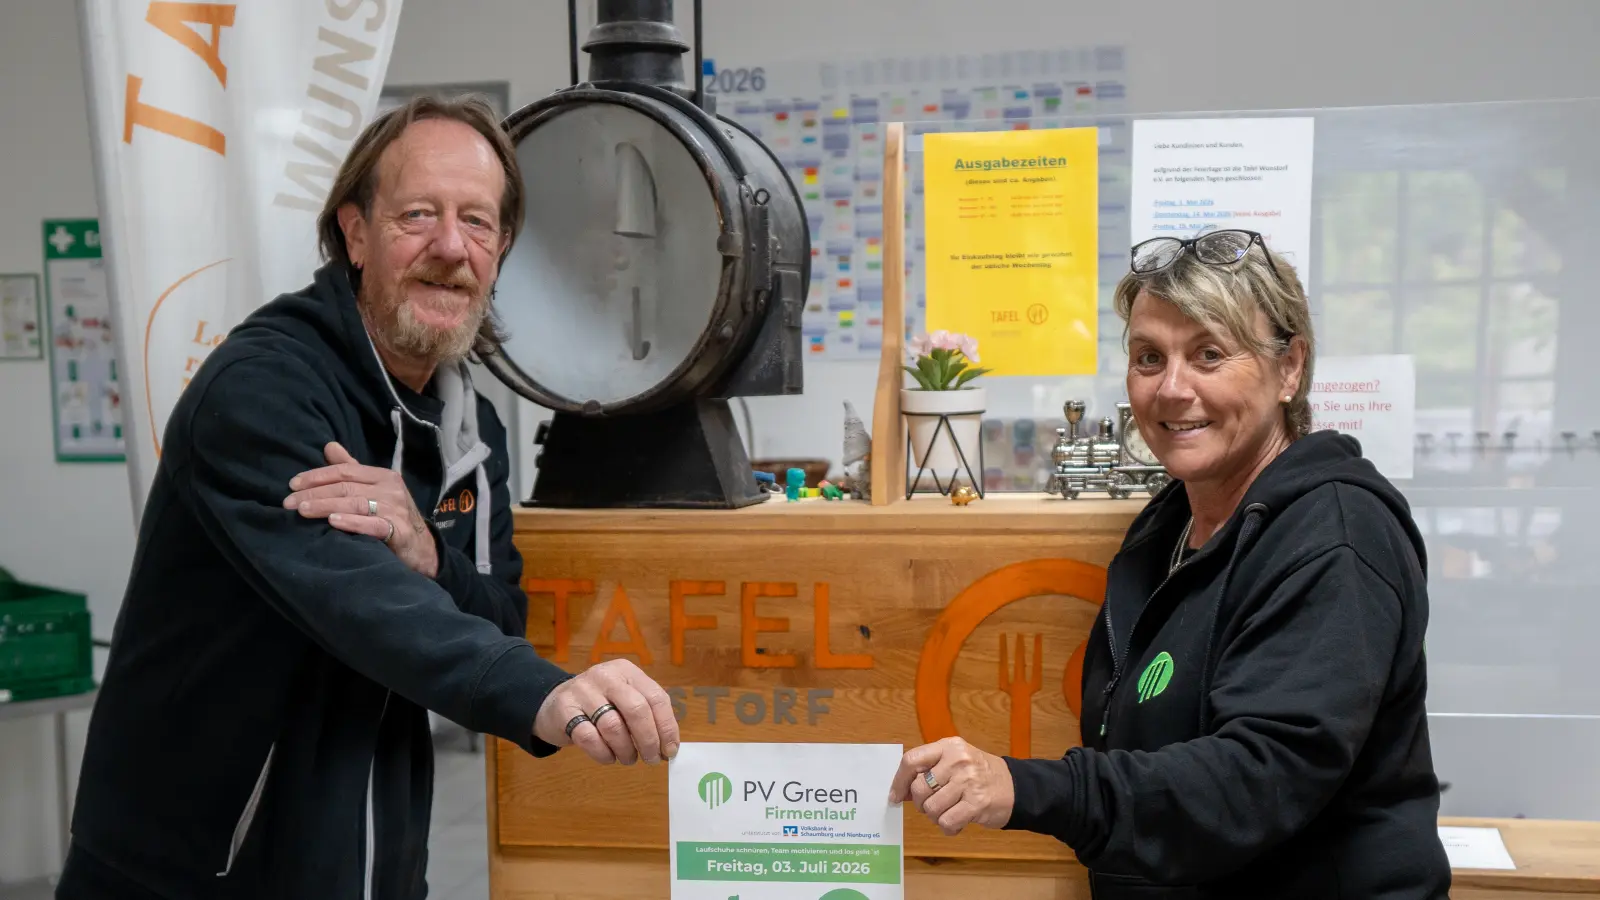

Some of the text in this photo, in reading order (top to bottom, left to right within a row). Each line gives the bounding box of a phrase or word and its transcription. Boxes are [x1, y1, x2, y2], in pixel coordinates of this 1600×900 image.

[705, 66, 765, 93] 2026
[955, 155, 1067, 171] Ausgabezeiten
[1153, 166, 1181, 174] aufgrund
[1193, 165, 1222, 173] Feiertage
[1243, 164, 1258, 172] Tafel
[1174, 175, 1205, 184] folgenden
[1206, 175, 1224, 183] Tagen
[962, 253, 1003, 261] Einkaufstag
[1005, 252, 1026, 260] bleibt
[990, 310, 1020, 323] TAFEL
[1313, 379, 1381, 392] mgezogen?
[1324, 401, 1341, 411] Sie
[1344, 402, 1365, 411] uns
[1368, 400, 1392, 411] Ihre
[1338, 419, 1363, 430] mit!
[526, 578, 875, 669] TAFEL
[743, 780, 858, 803] PV Green
[765, 805, 857, 821] Firmenlauf
[800, 831, 834, 839] Schaumburg
[736, 846, 770, 855] schnüren,
[707, 858, 871, 876] Freitag, 03. Juli 2026
